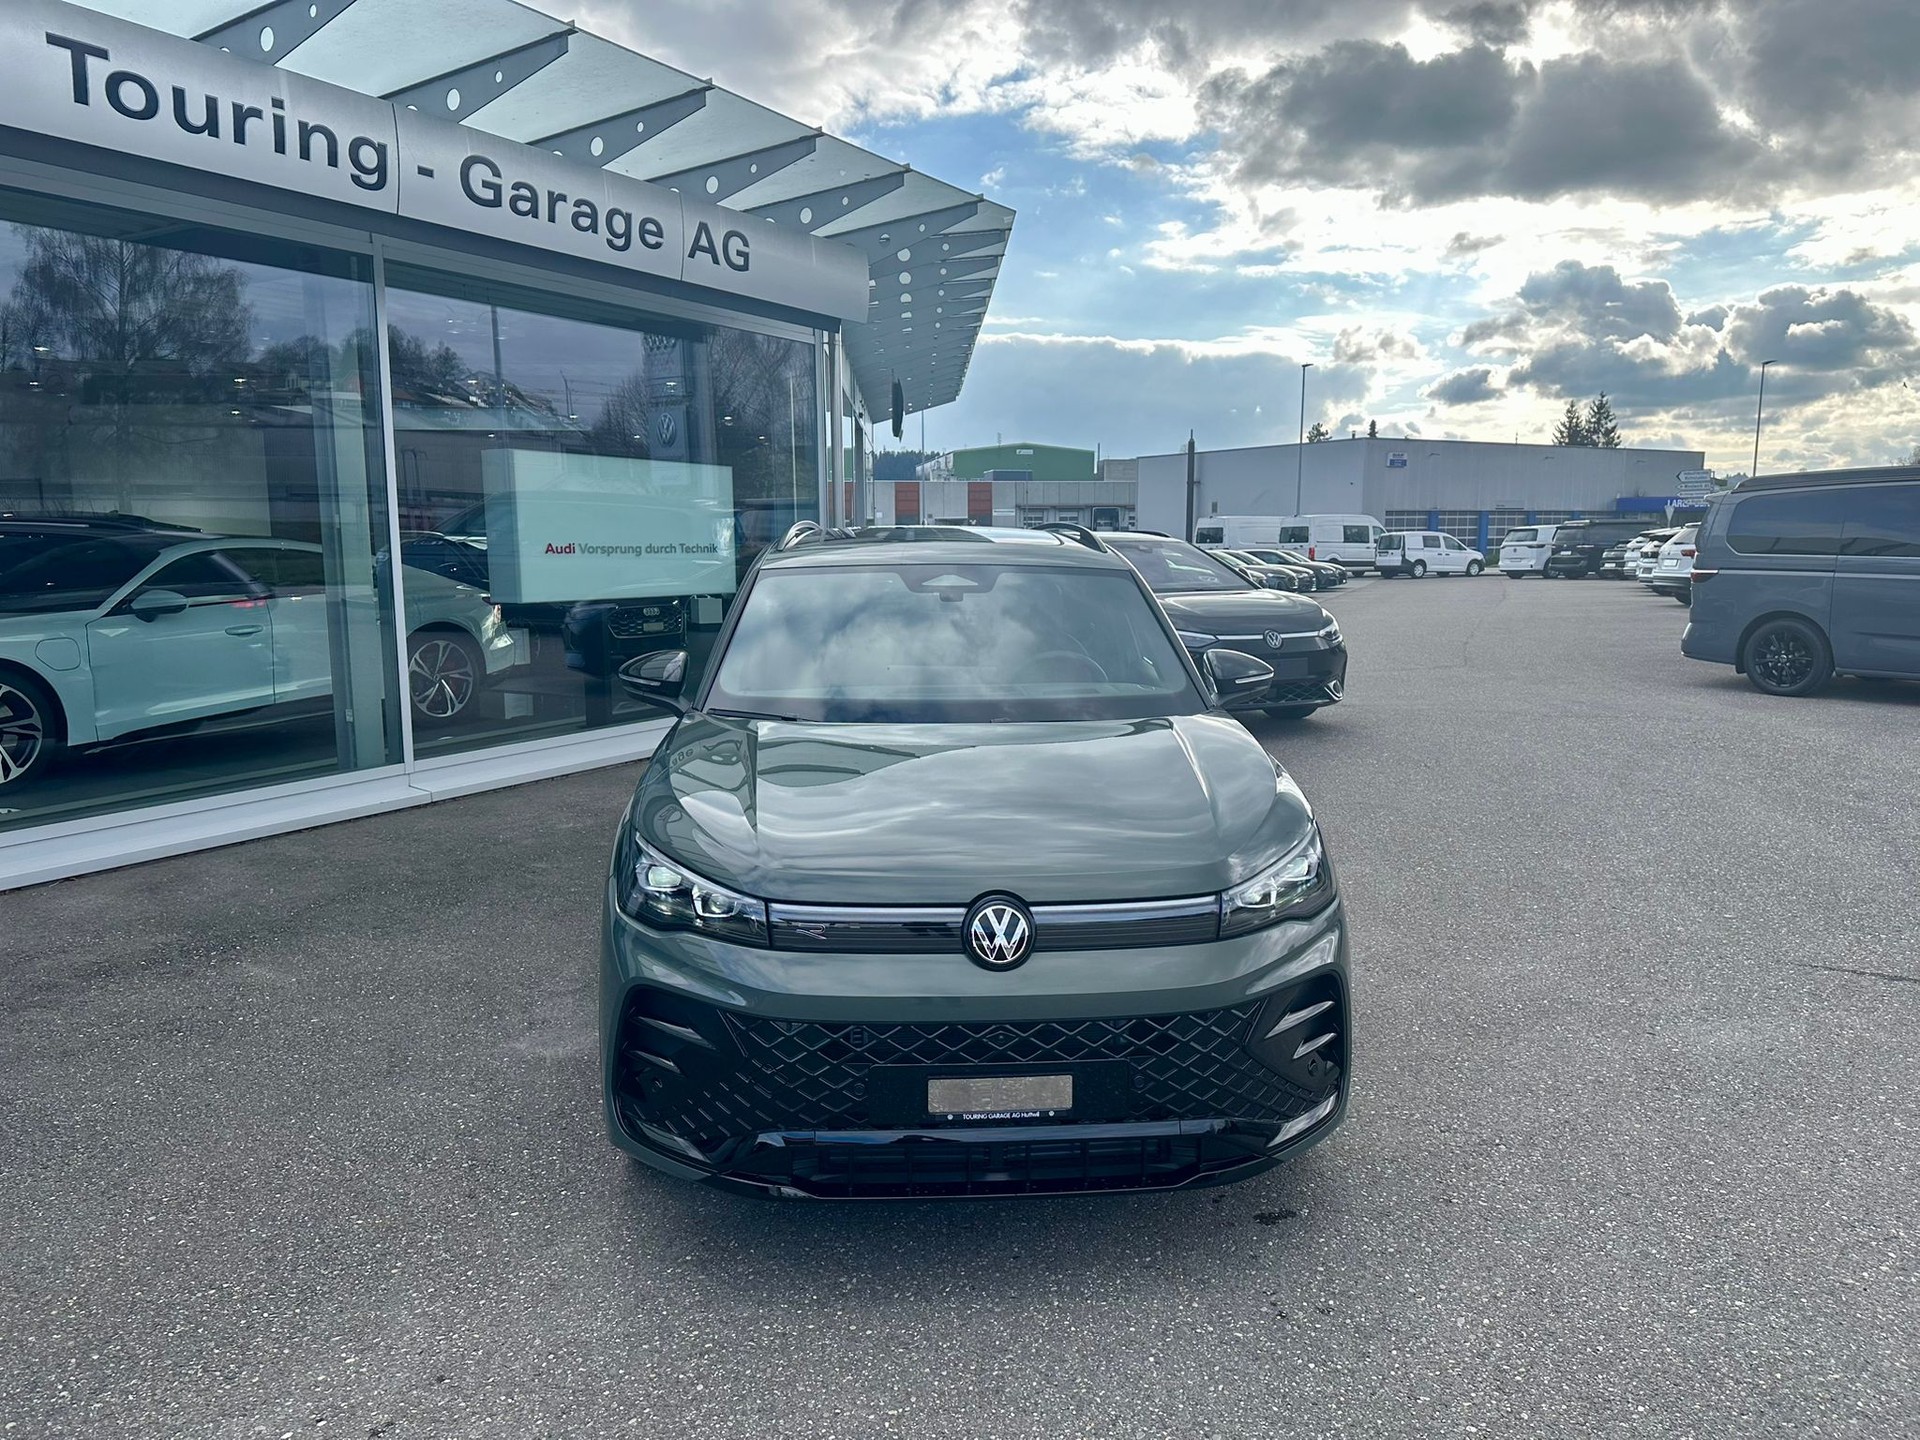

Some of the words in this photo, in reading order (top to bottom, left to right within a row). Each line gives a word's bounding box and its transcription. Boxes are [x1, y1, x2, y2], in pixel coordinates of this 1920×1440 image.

[45, 31, 388, 191] Touring
[460, 154, 665, 251] Garage
[688, 220, 750, 272] AG
[545, 543, 576, 555] Audi
[579, 543, 642, 557] Vorsprung
[645, 543, 677, 555] durch
[679, 543, 718, 555] Technik
